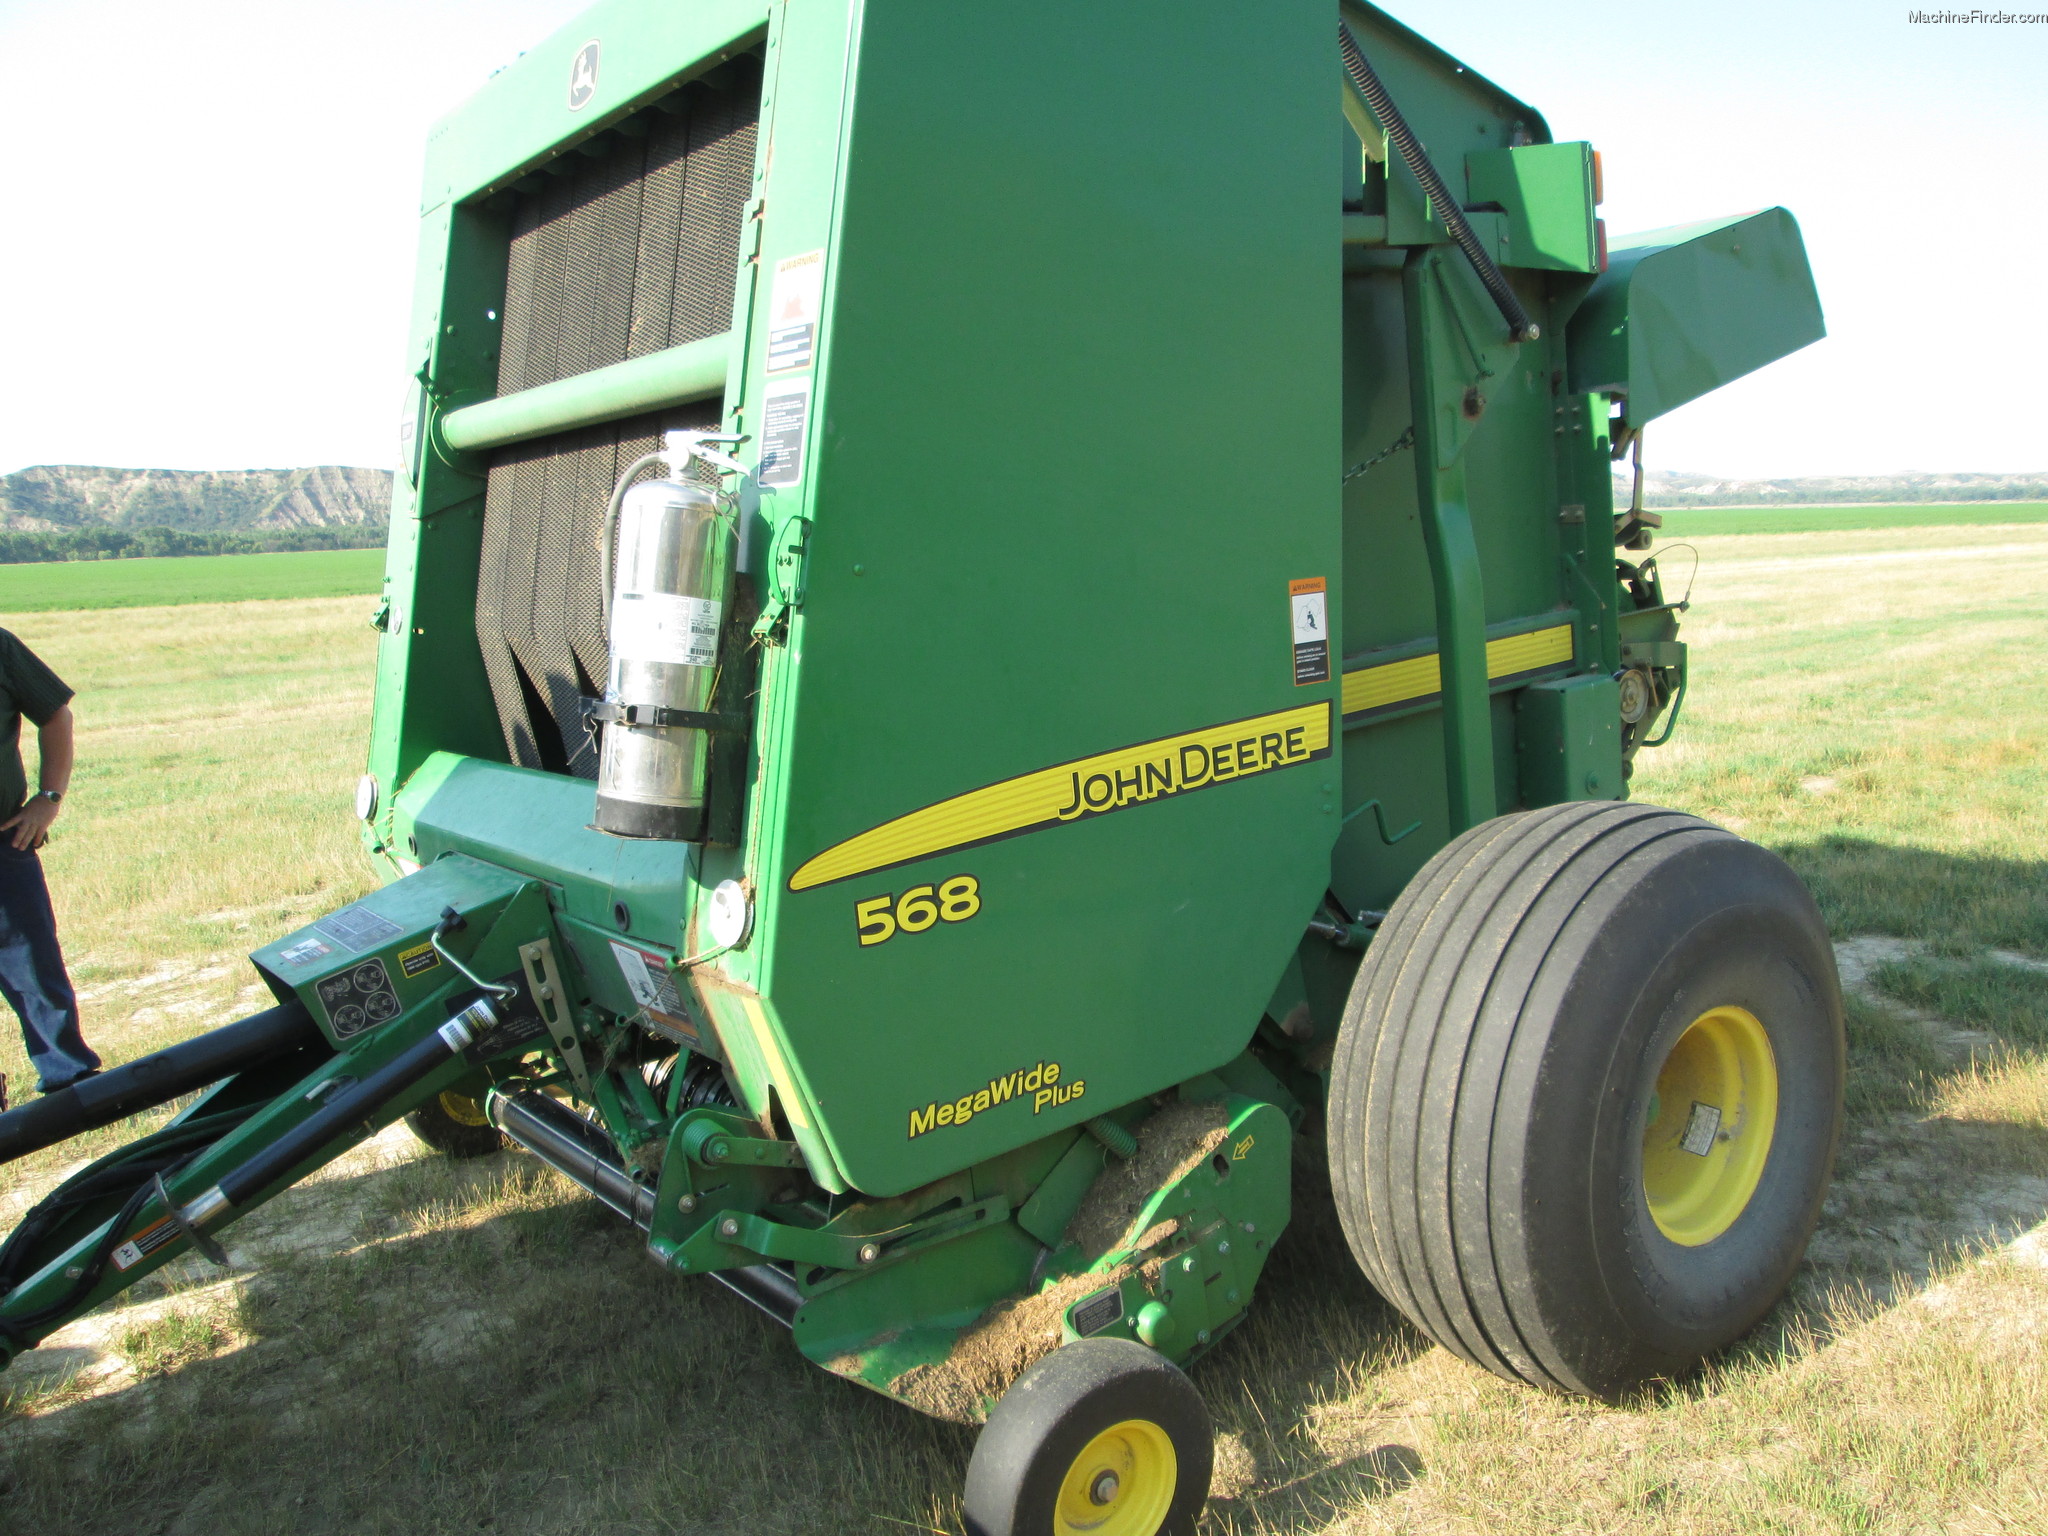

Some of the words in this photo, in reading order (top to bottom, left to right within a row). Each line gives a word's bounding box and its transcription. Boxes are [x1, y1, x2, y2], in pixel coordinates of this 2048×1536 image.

[1058, 757, 1174, 818] JOHN
[1179, 725, 1308, 786] DEERE
[855, 873, 982, 948] 568
[908, 1060, 1061, 1140] MegaWide
[1033, 1079, 1086, 1116] Plus
